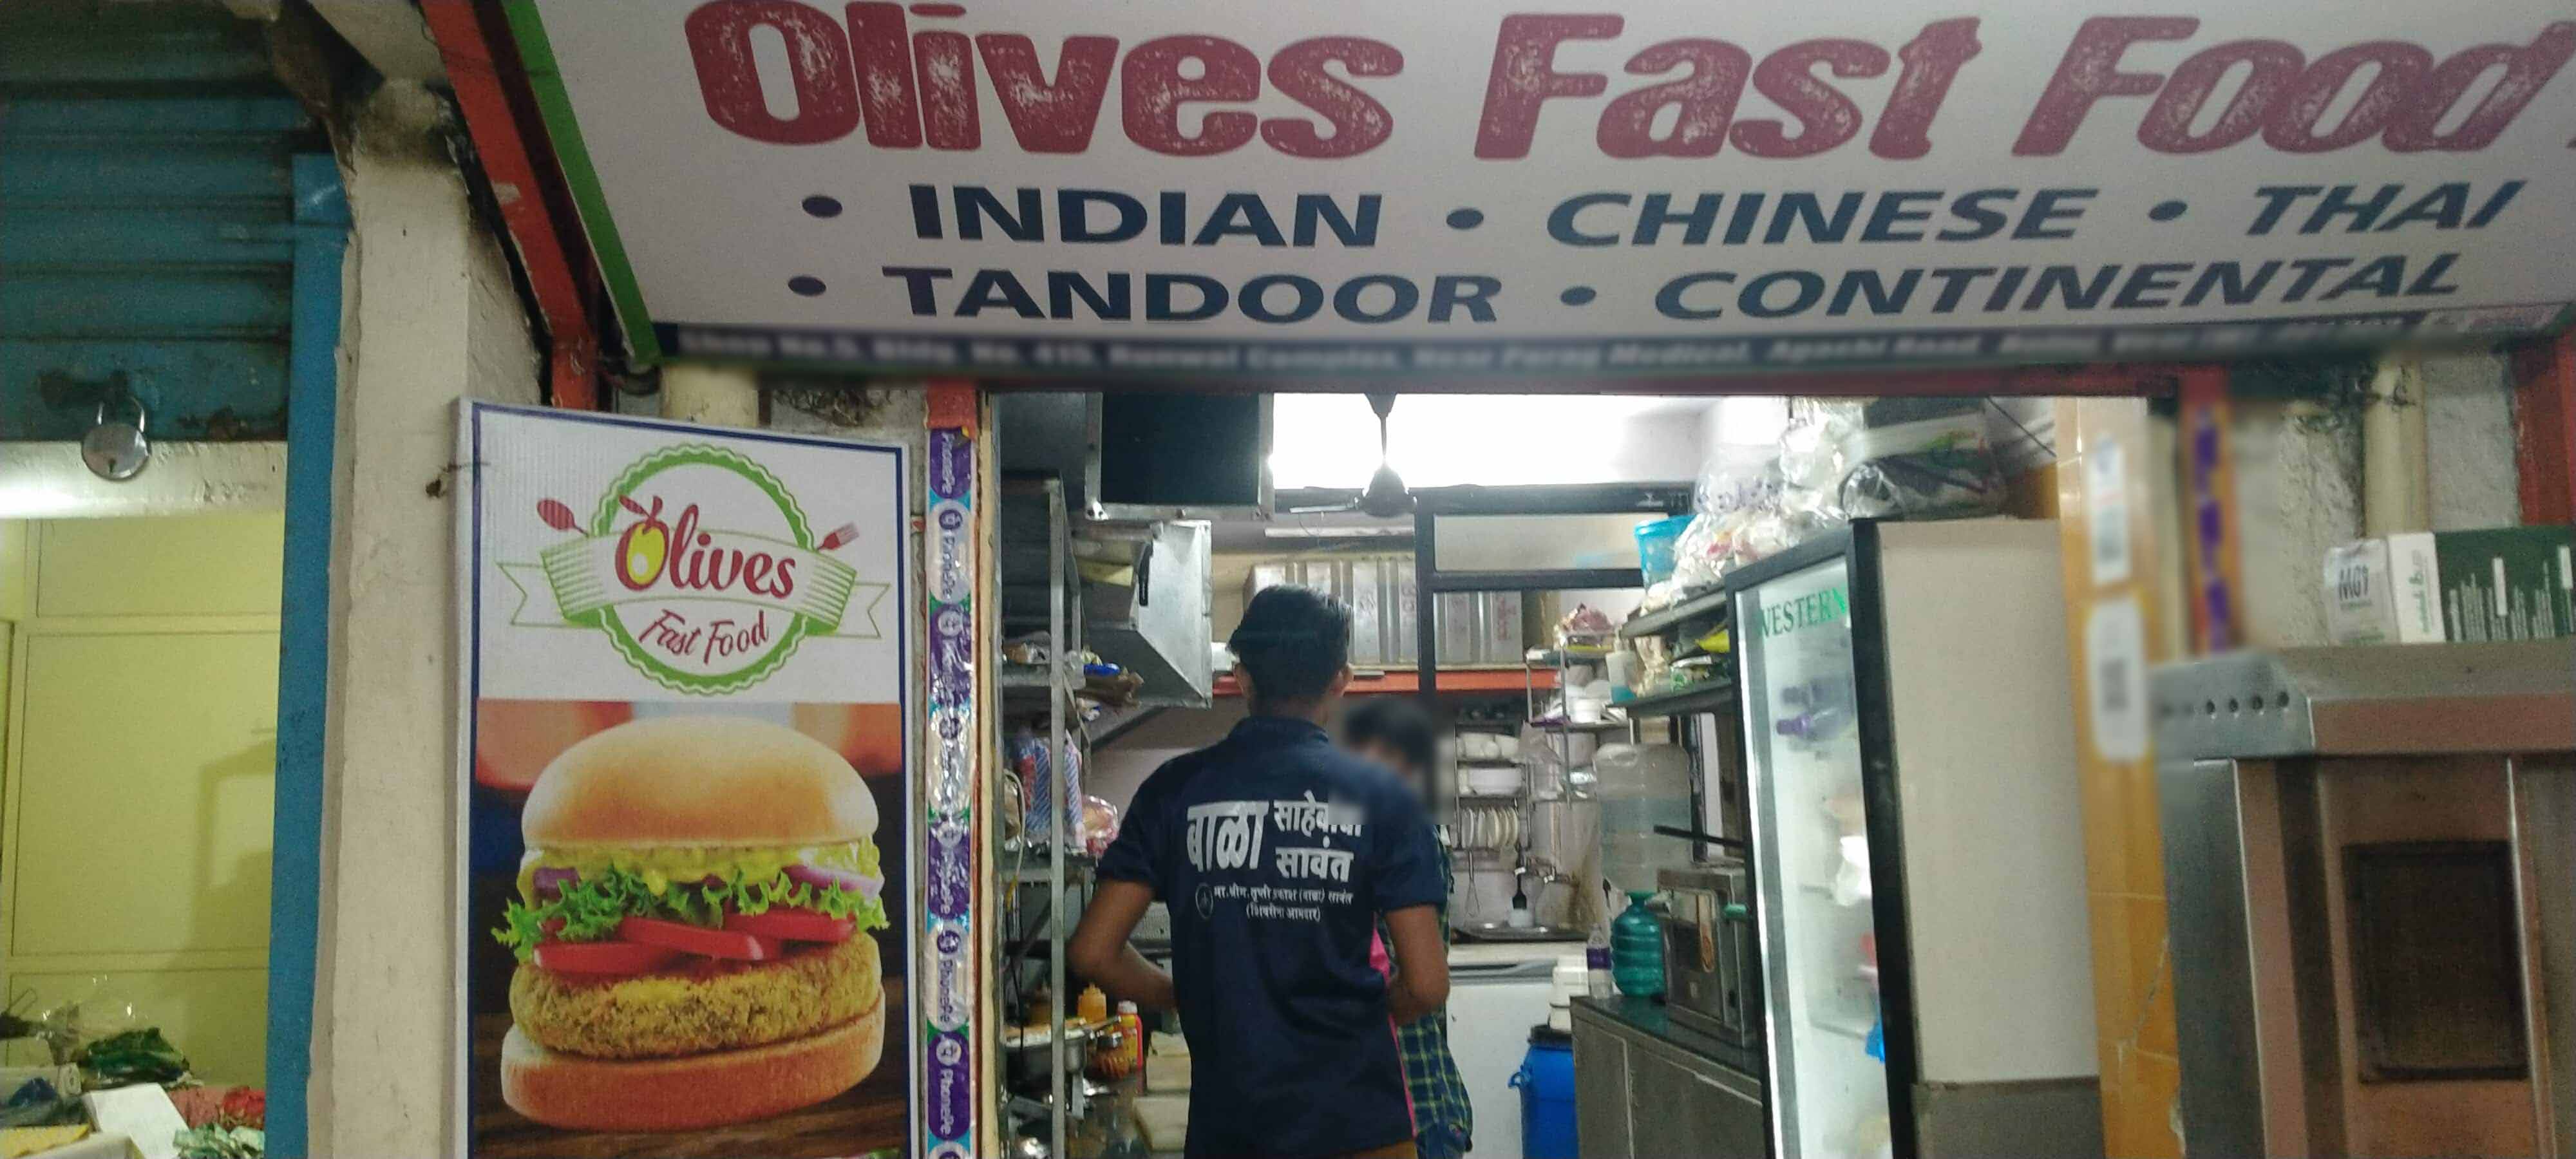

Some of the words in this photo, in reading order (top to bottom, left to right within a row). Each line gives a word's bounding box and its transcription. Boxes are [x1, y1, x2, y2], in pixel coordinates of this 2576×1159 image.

[685, 0, 1405, 160] Olives
[1473, 13, 1982, 160] Fast
[2011, 16, 2576, 156] Food
[909, 184, 1383, 247] INDIAN
[1546, 187, 2099, 247] CHINESE
[2247, 179, 2528, 237] THAI
[882, 265, 1503, 325] TANDOOR
[1655, 254, 2461, 321] CONTINENTAL
[615, 497, 796, 599] Olives
[639, 608, 702, 656] Fast
[703, 610, 770, 665] Food
[1754, 587, 1846, 637] WESTERN
[1187, 800, 1269, 872] बाळा
[1275, 836, 1354, 882] सावंत
[938, 959, 954, 1023] PhonePe
[938, 1069, 954, 1136] PhonePe
